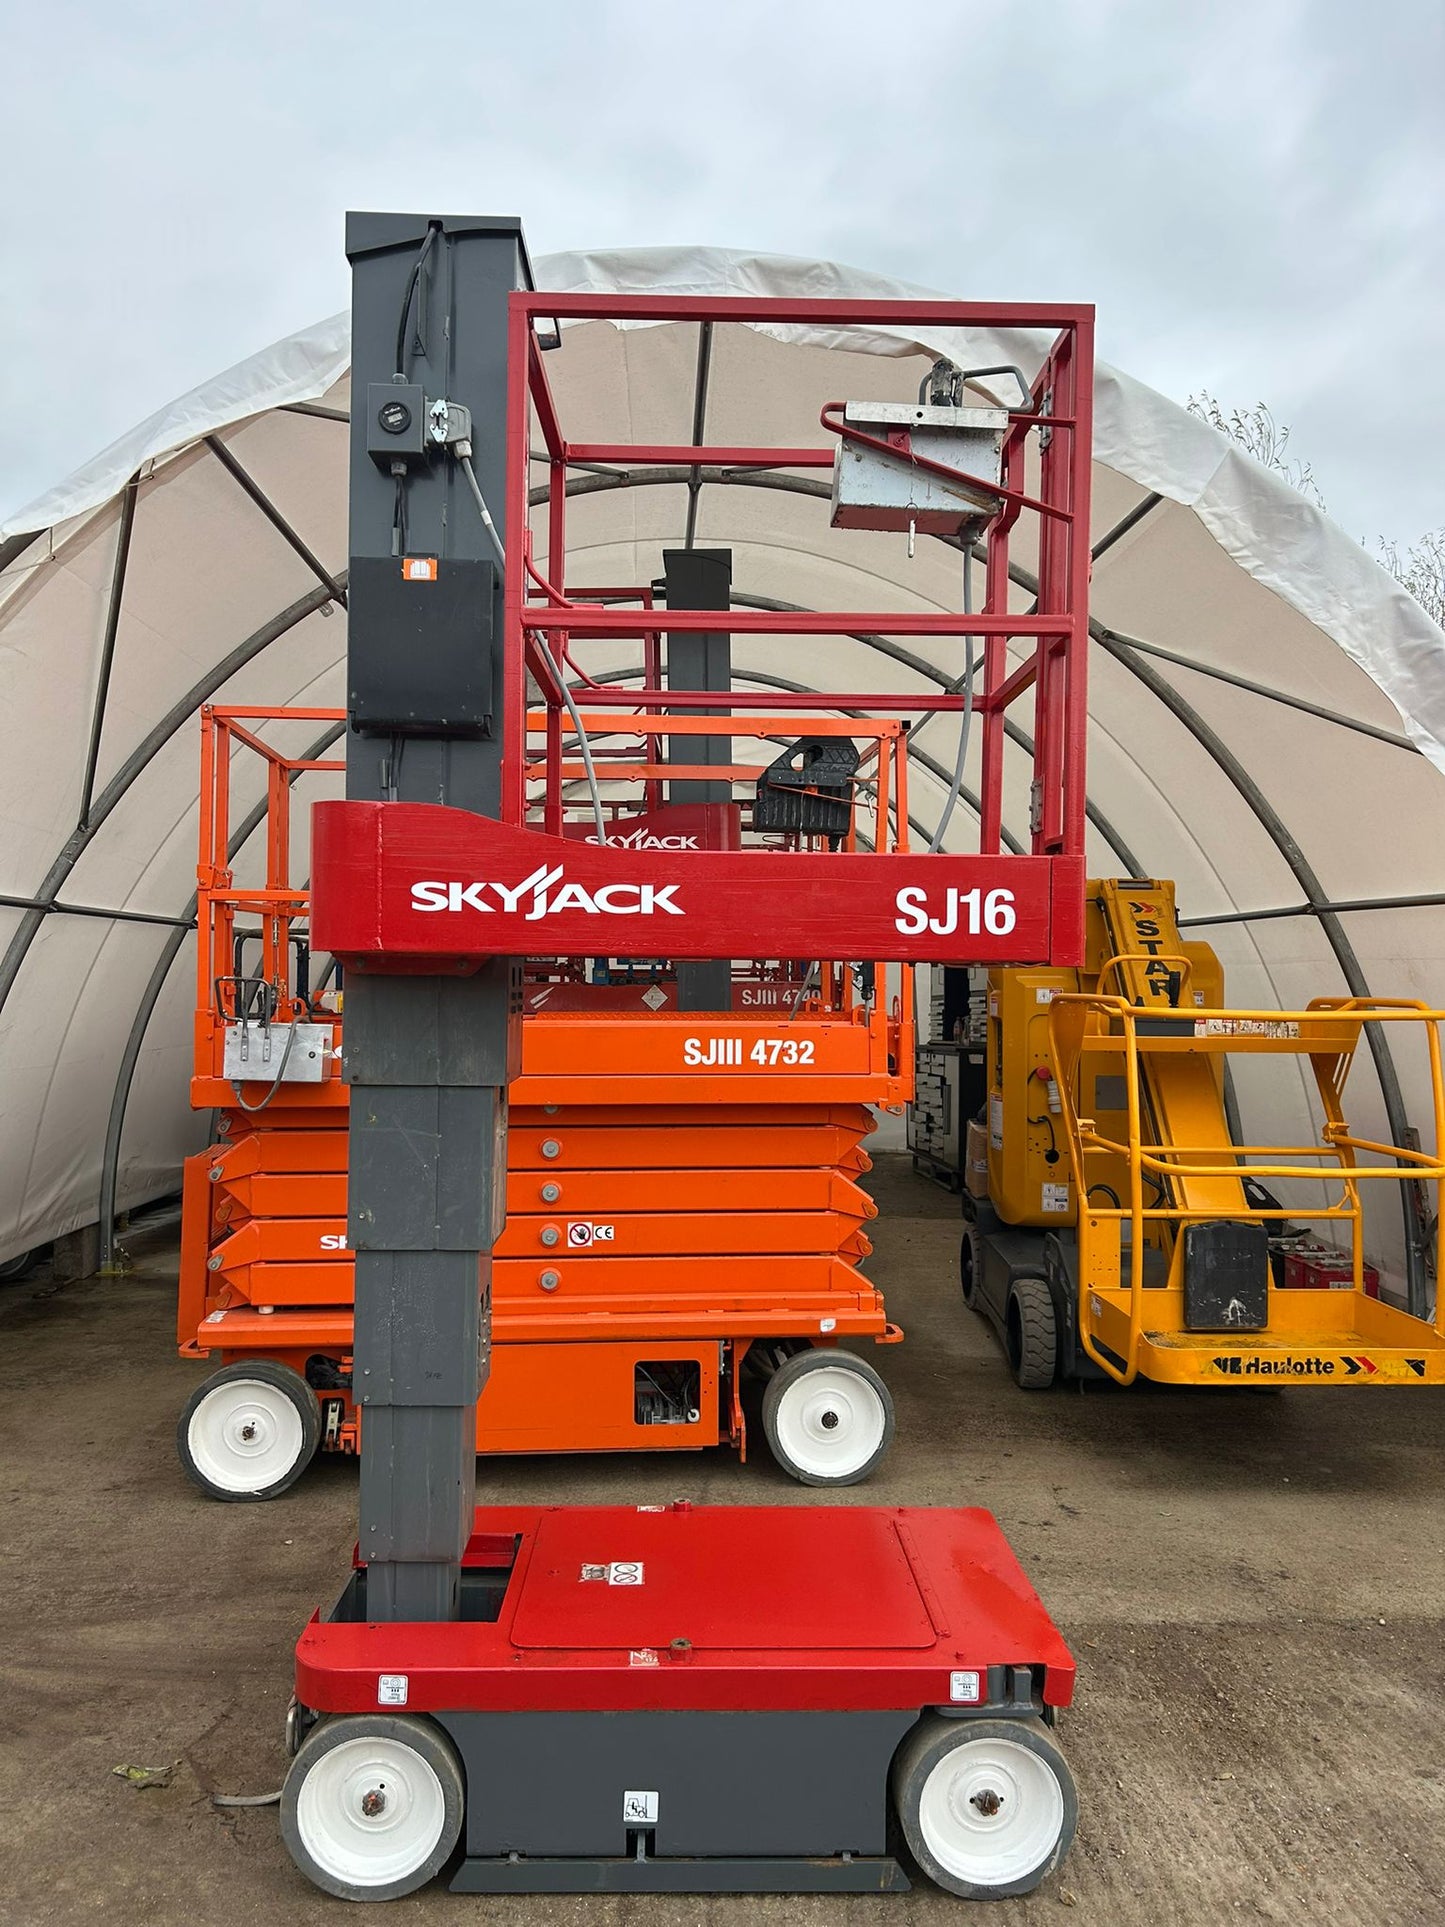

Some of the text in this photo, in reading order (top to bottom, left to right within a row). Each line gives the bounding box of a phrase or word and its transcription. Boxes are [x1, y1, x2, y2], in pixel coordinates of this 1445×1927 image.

[584, 828, 700, 850] SKYJACK
[410, 863, 686, 921] SKYJACK
[895, 886, 1017, 935] SJ16
[1135, 919, 1171, 996] STAR
[683, 1038, 815, 1066] SJIII 4732
[594, 1226, 613, 1240] CE
[1245, 1356, 1335, 1375] Haulotte
